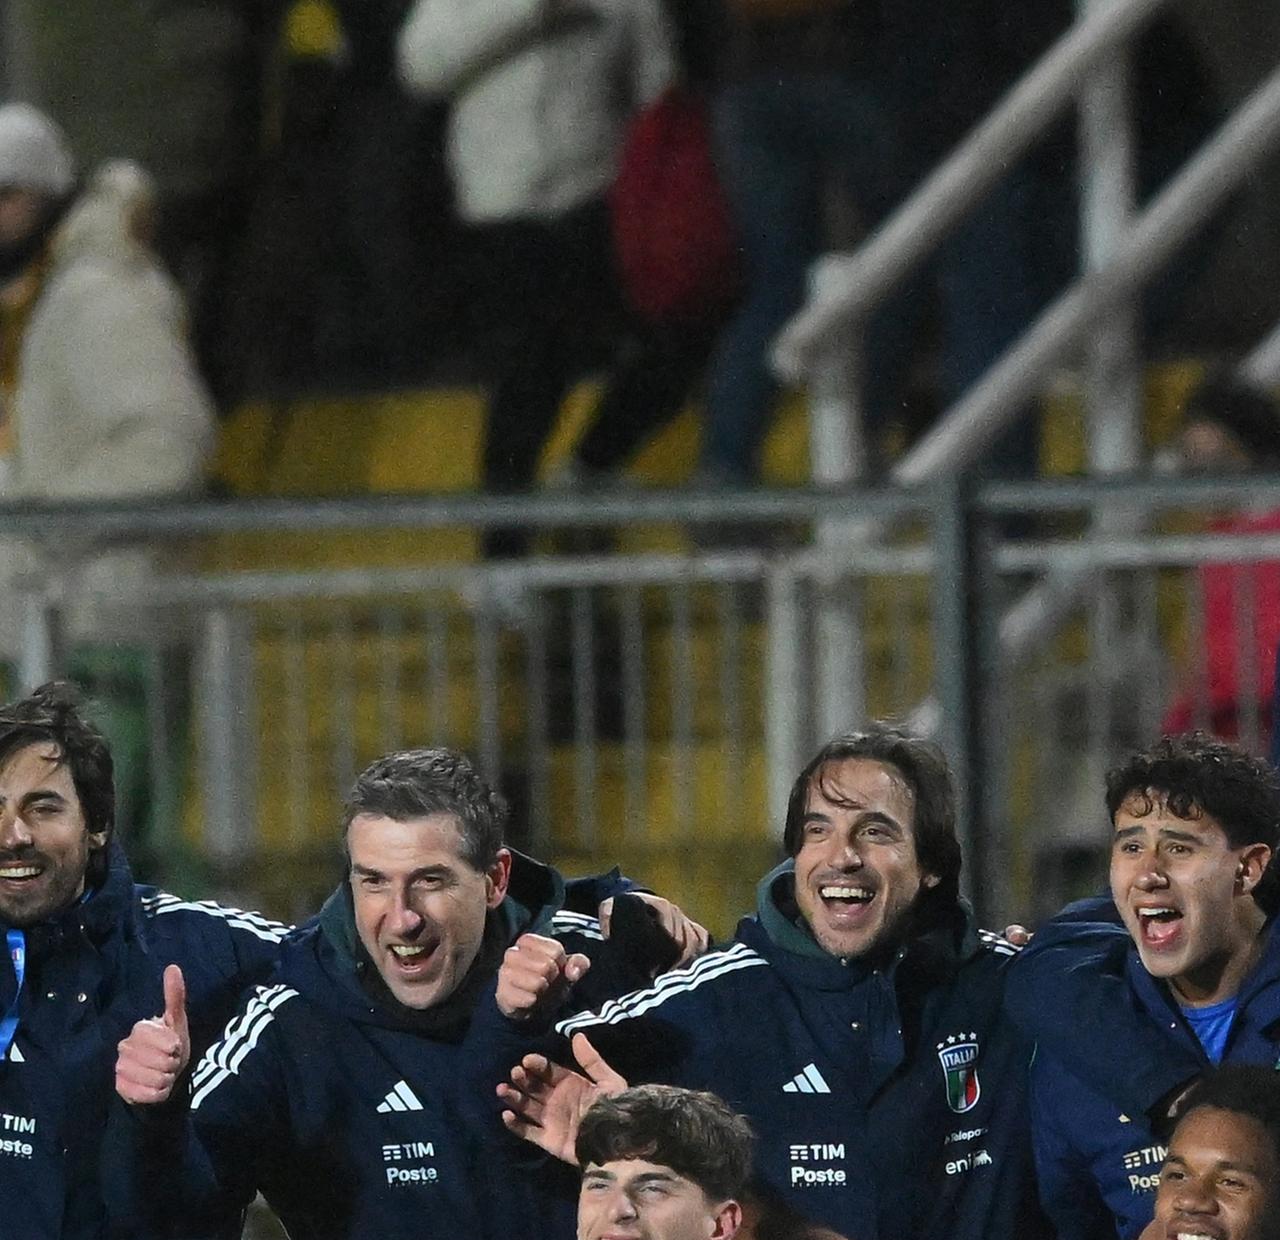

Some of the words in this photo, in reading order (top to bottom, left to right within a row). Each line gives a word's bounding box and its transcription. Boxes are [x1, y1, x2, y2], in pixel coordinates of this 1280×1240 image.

[943, 1048, 976, 1067] ITALIA
[3, 1114, 36, 1134] TIM
[402, 1142, 435, 1159] TIM
[810, 1144, 845, 1160] TIM
[945, 1154, 972, 1175] eni
[386, 1166, 438, 1184] Poste
[791, 1166, 846, 1184] Poste
